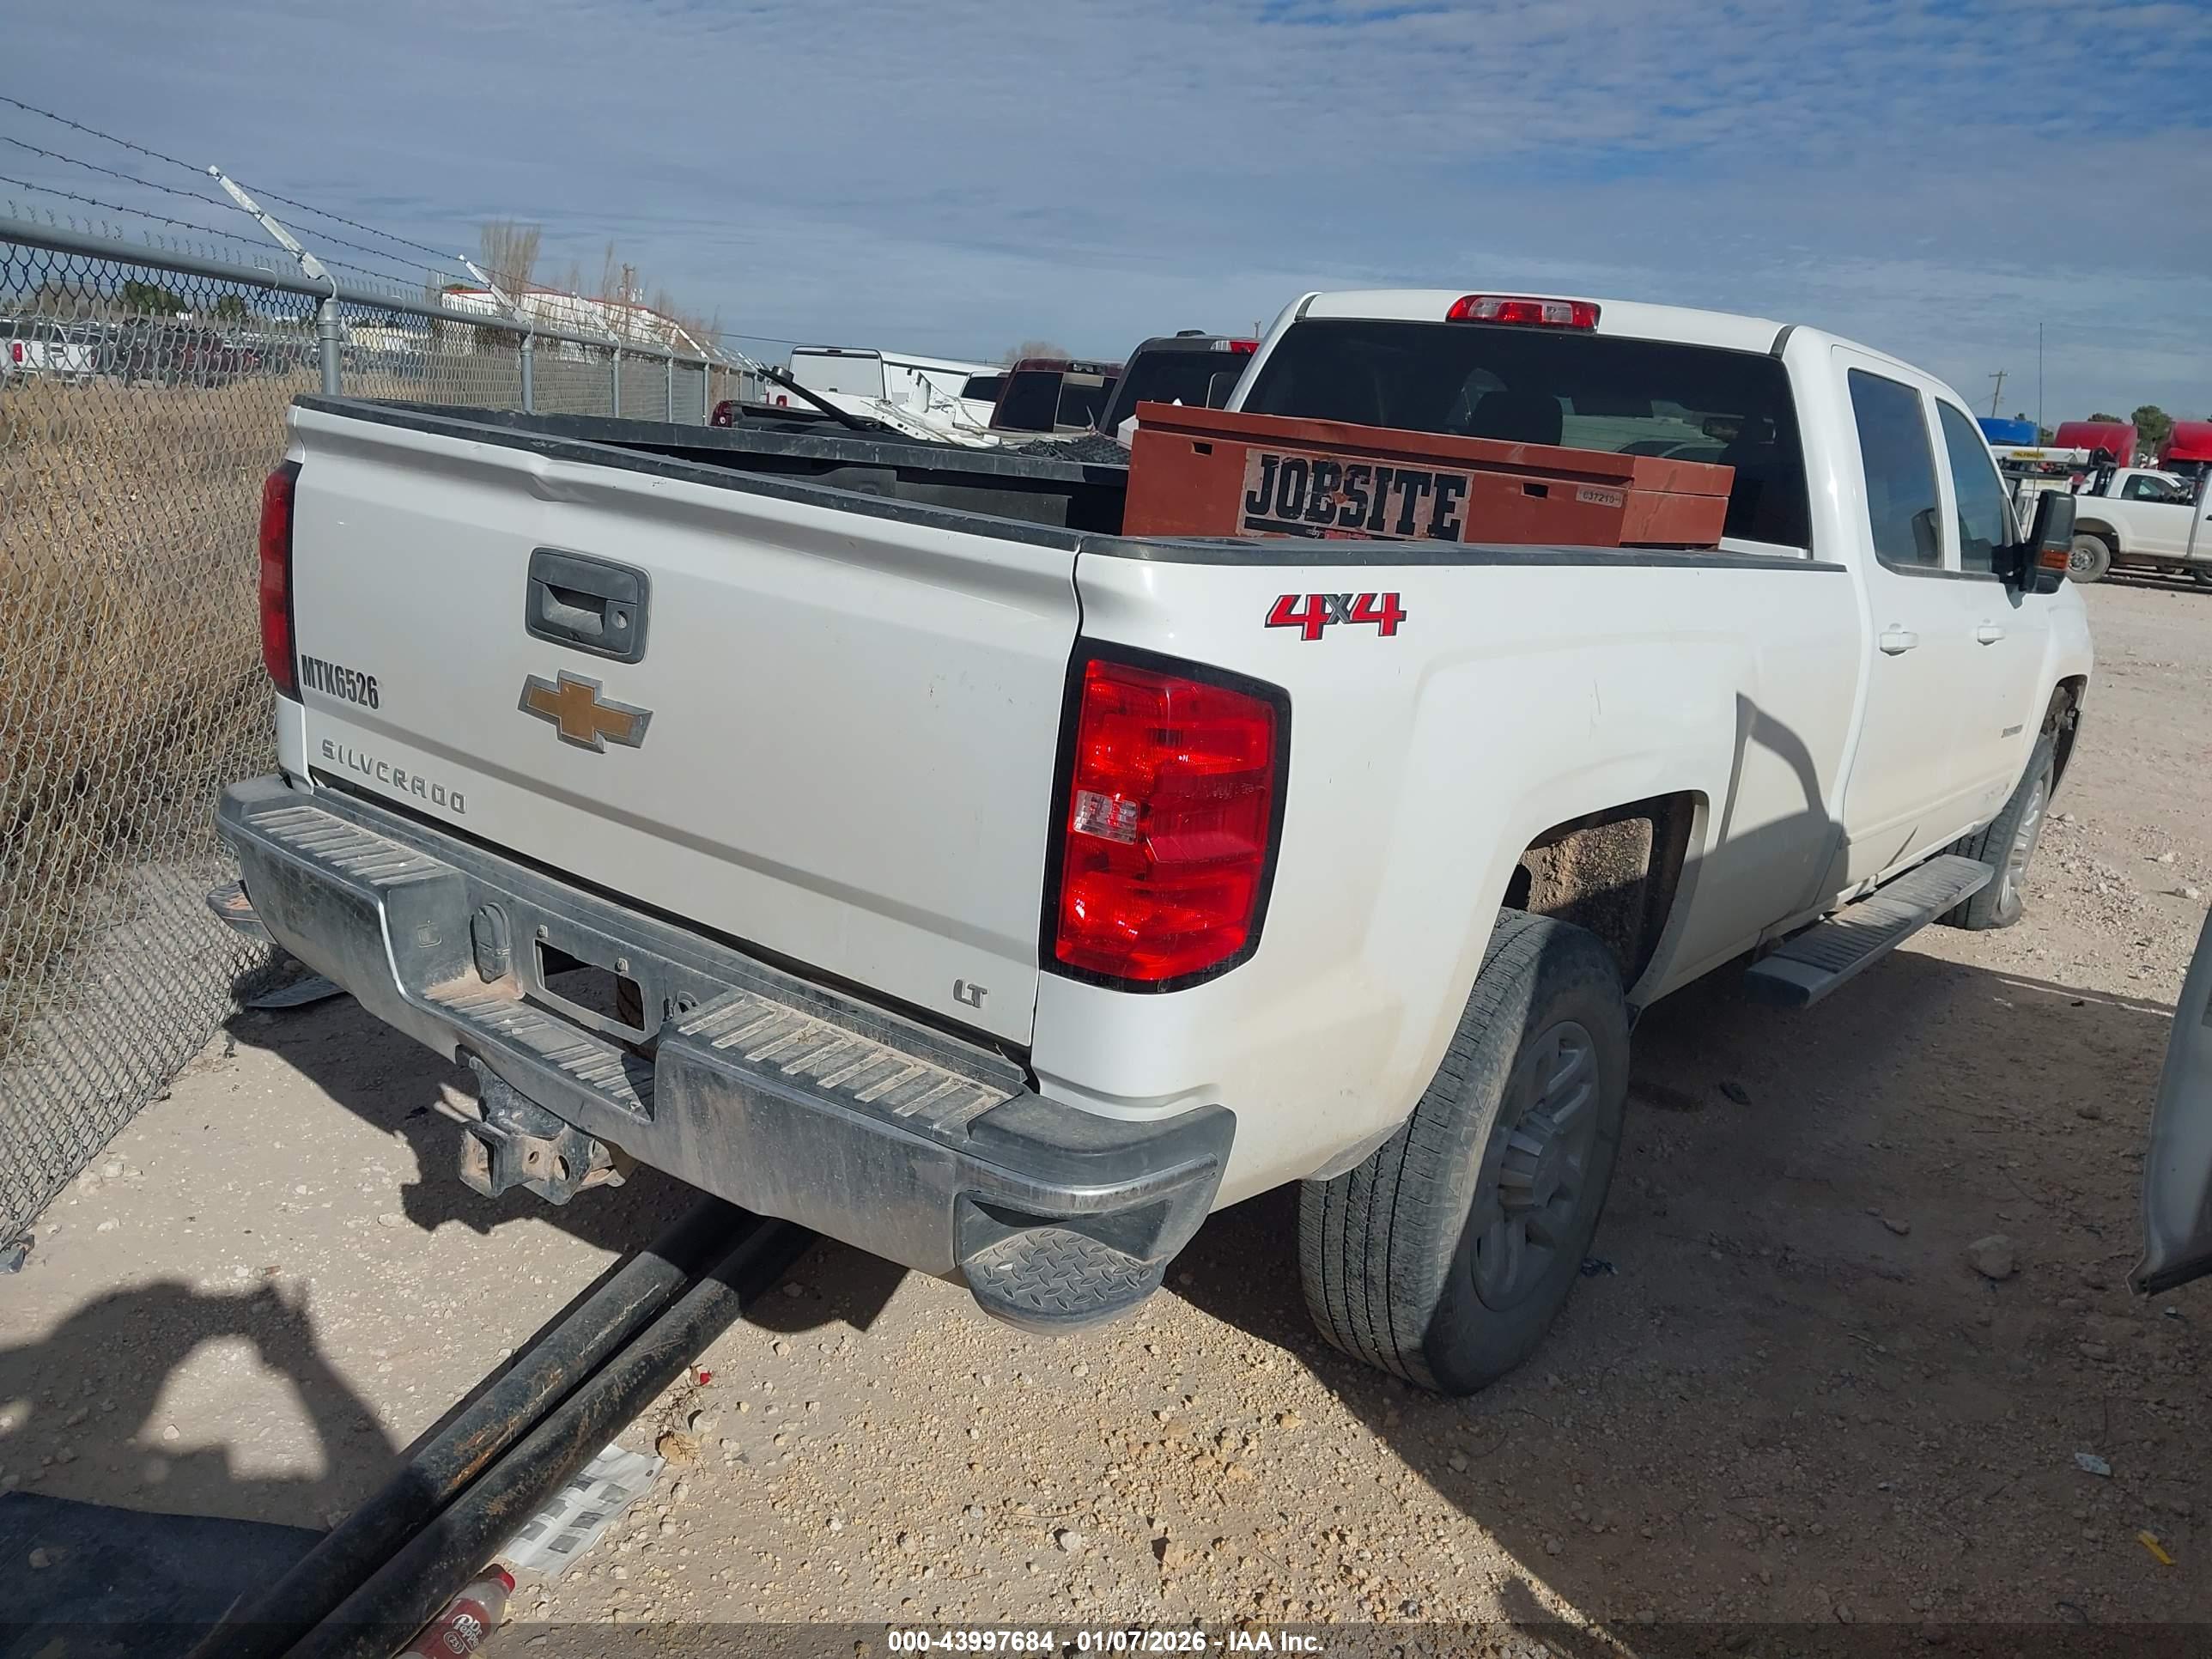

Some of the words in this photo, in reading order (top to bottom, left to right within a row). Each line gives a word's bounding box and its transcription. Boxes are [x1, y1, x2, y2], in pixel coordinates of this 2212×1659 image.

[1245, 454, 1468, 542] JOBSITE
[301, 654, 379, 709] MTK6526
[321, 738, 466, 815] SILVERADO
[953, 979, 988, 1008] LT
[449, 1636, 459, 1648] 23
[469, 1619, 483, 1636] Dr
